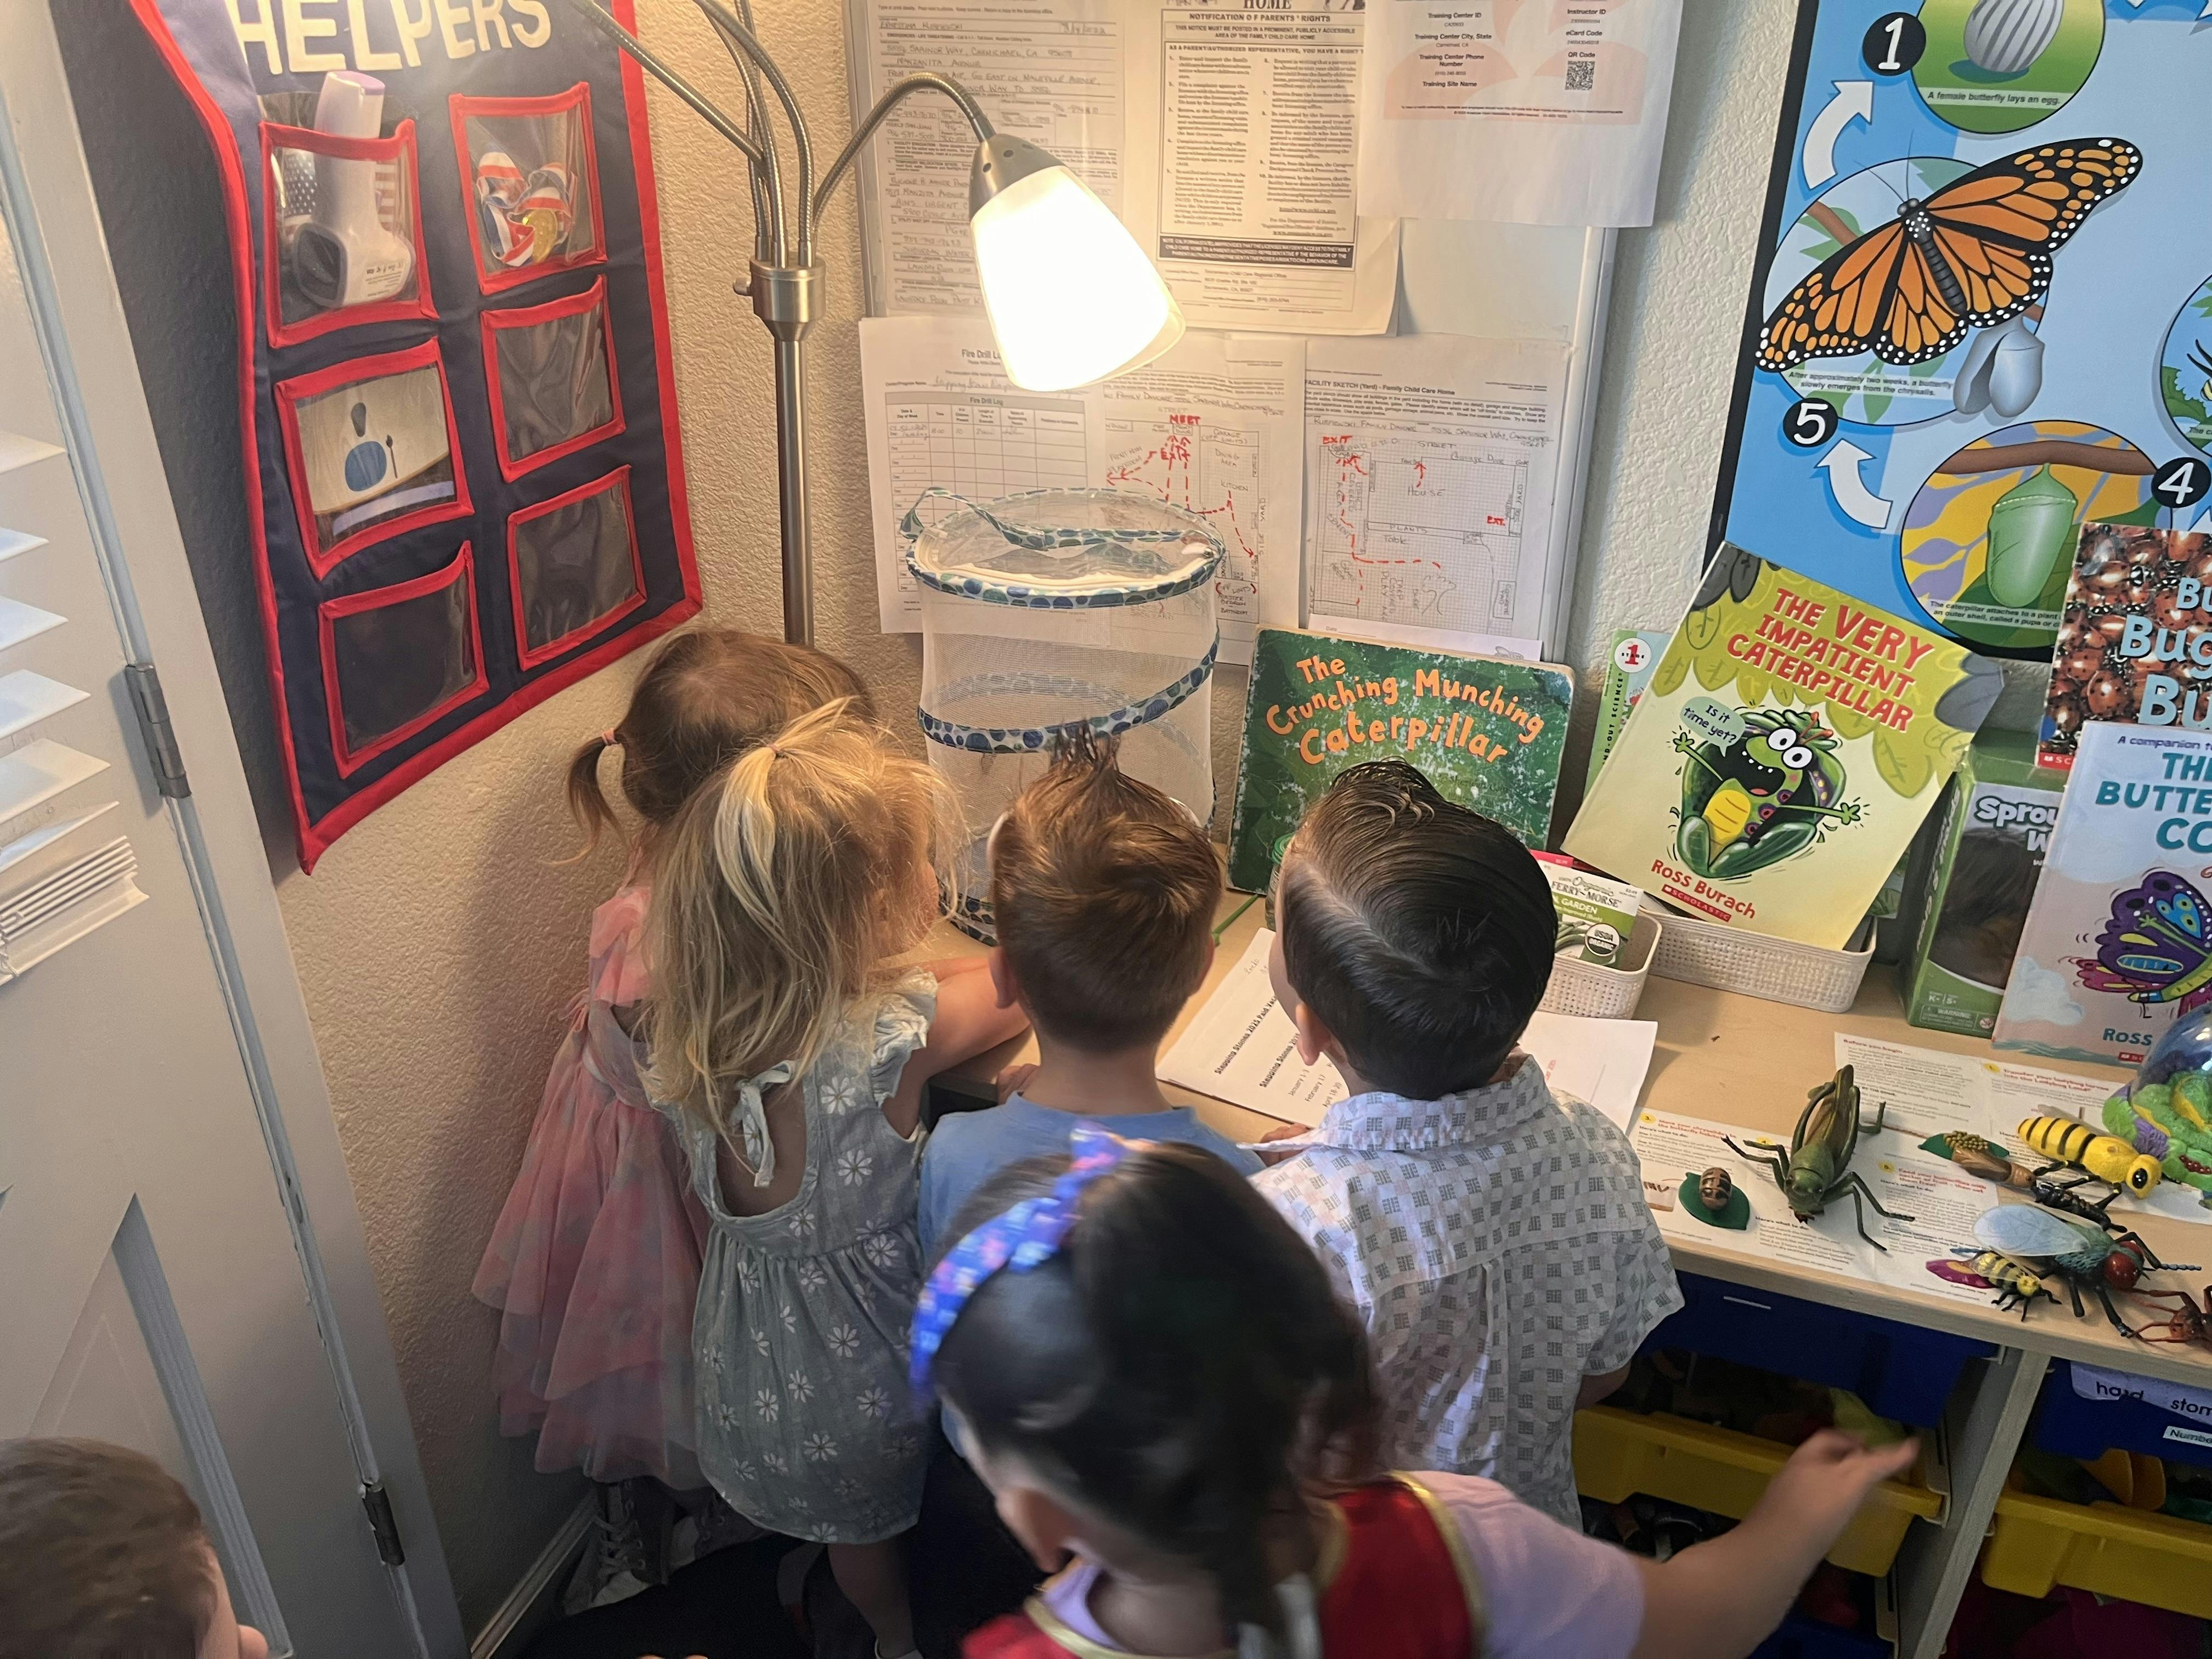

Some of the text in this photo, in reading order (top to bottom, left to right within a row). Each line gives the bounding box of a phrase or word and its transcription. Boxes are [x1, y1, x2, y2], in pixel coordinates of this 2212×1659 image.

[226, 0, 551, 74] HELPERS
[1878, 17, 1905, 70] 1
[1968, 93, 2005, 103] butterfly
[2007, 94, 2025, 104] lays
[2041, 97, 2060, 105] egg.
[961, 349, 975, 357] Fire
[977, 349, 991, 358] Drill
[1383, 385, 1402, 393] Family
[1801, 381, 1826, 390] slowly
[1827, 382, 1860, 392] emerges
[1883, 385, 1895, 393] the
[1898, 387, 1936, 397] chrysalis.
[1809, 373, 1864, 383] approximately
[1918, 379, 1951, 390] butterfly
[1793, 403, 1827, 444] 5
[1322, 435, 1353, 444] EXIT
[2158, 463, 2193, 504] 4
[1945, 603, 1984, 613] caterpillar
[1986, 608, 2019, 616] attaches
[1967, 613, 1988, 622] shell,
[1772, 587, 1935, 673] THE VERY
[1625, 645, 1639, 665] 1
[1754, 613, 1916, 699] IMPATIENT
[1297, 655, 1346, 684] The
[1726, 633, 1915, 733] CATERPILLAR
[1266, 669, 1545, 744] Crunching Munching
[1706, 705, 1730, 723] Is it
[1684, 708, 1737, 743] time yet?
[1299, 711, 1508, 765] Caterpillar
[2117, 736, 2126, 744] A
[2130, 737, 2200, 748] companion
[2156, 818, 2212, 854] CO
[1561, 898, 1598, 914] GARDEN
[1671, 889, 1729, 920] SCHOLASTIC
[1694, 881, 1755, 918] Burach
[1589, 938, 1614, 951] ORGANIC
[1594, 929, 1613, 941] USDA
[1305, 1080, 1323, 1103] February
